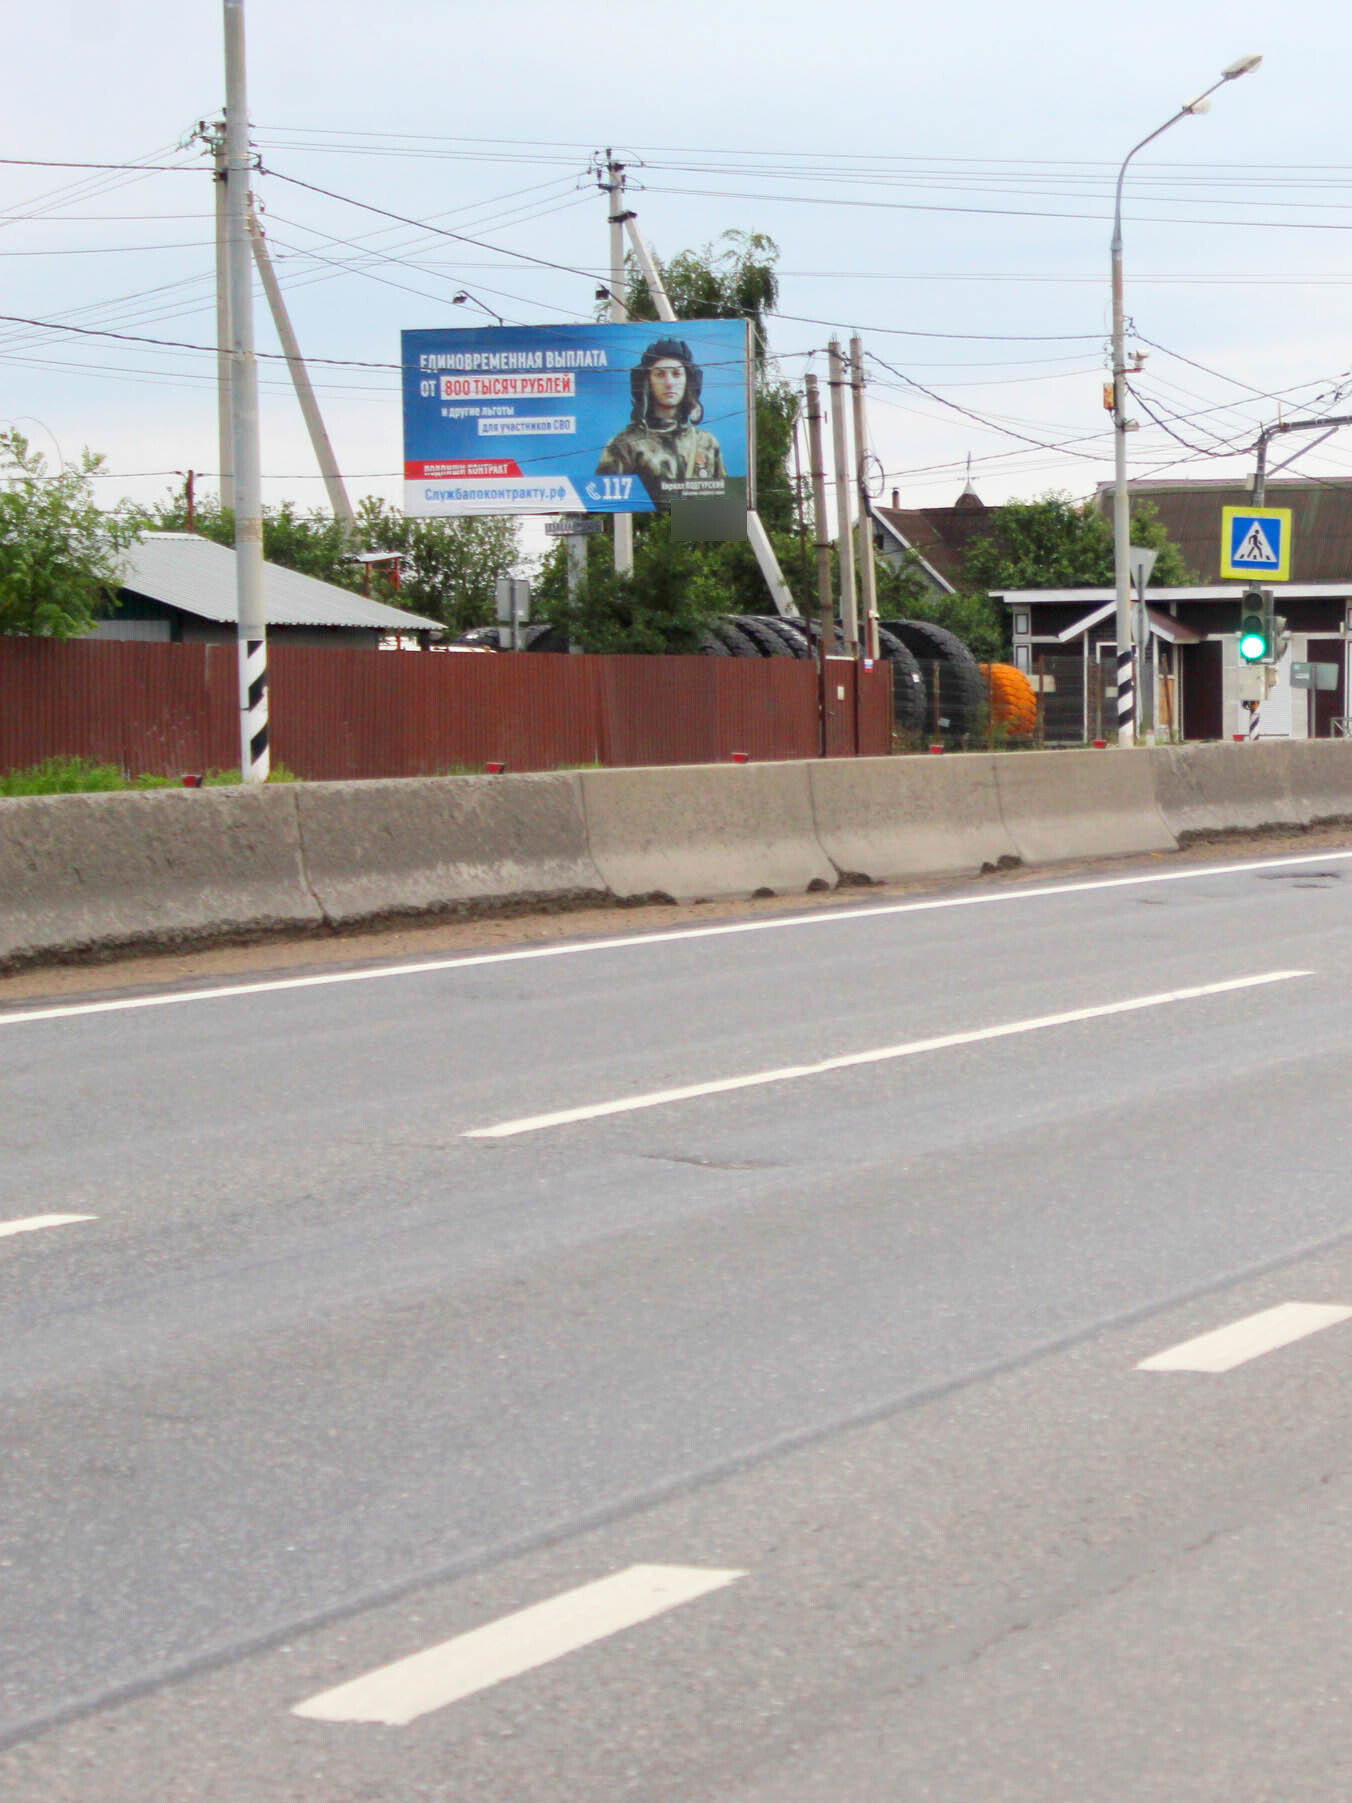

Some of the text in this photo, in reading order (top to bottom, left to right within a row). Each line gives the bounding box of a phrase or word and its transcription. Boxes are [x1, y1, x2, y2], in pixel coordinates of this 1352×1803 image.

[420, 349, 608, 373] ЕДИНОВРЕМЕННАЯ ВЫПЛАТА
[420, 373, 571, 398] ОТ 800 ТЫСЯЧ РУБЛЕЙ
[449, 407, 480, 420] другие
[482, 406, 515, 417] льготы
[482, 419, 571, 434] для участников СВО
[467, 463, 509, 475] КОНТРАКТ
[602, 478, 633, 500] 117
